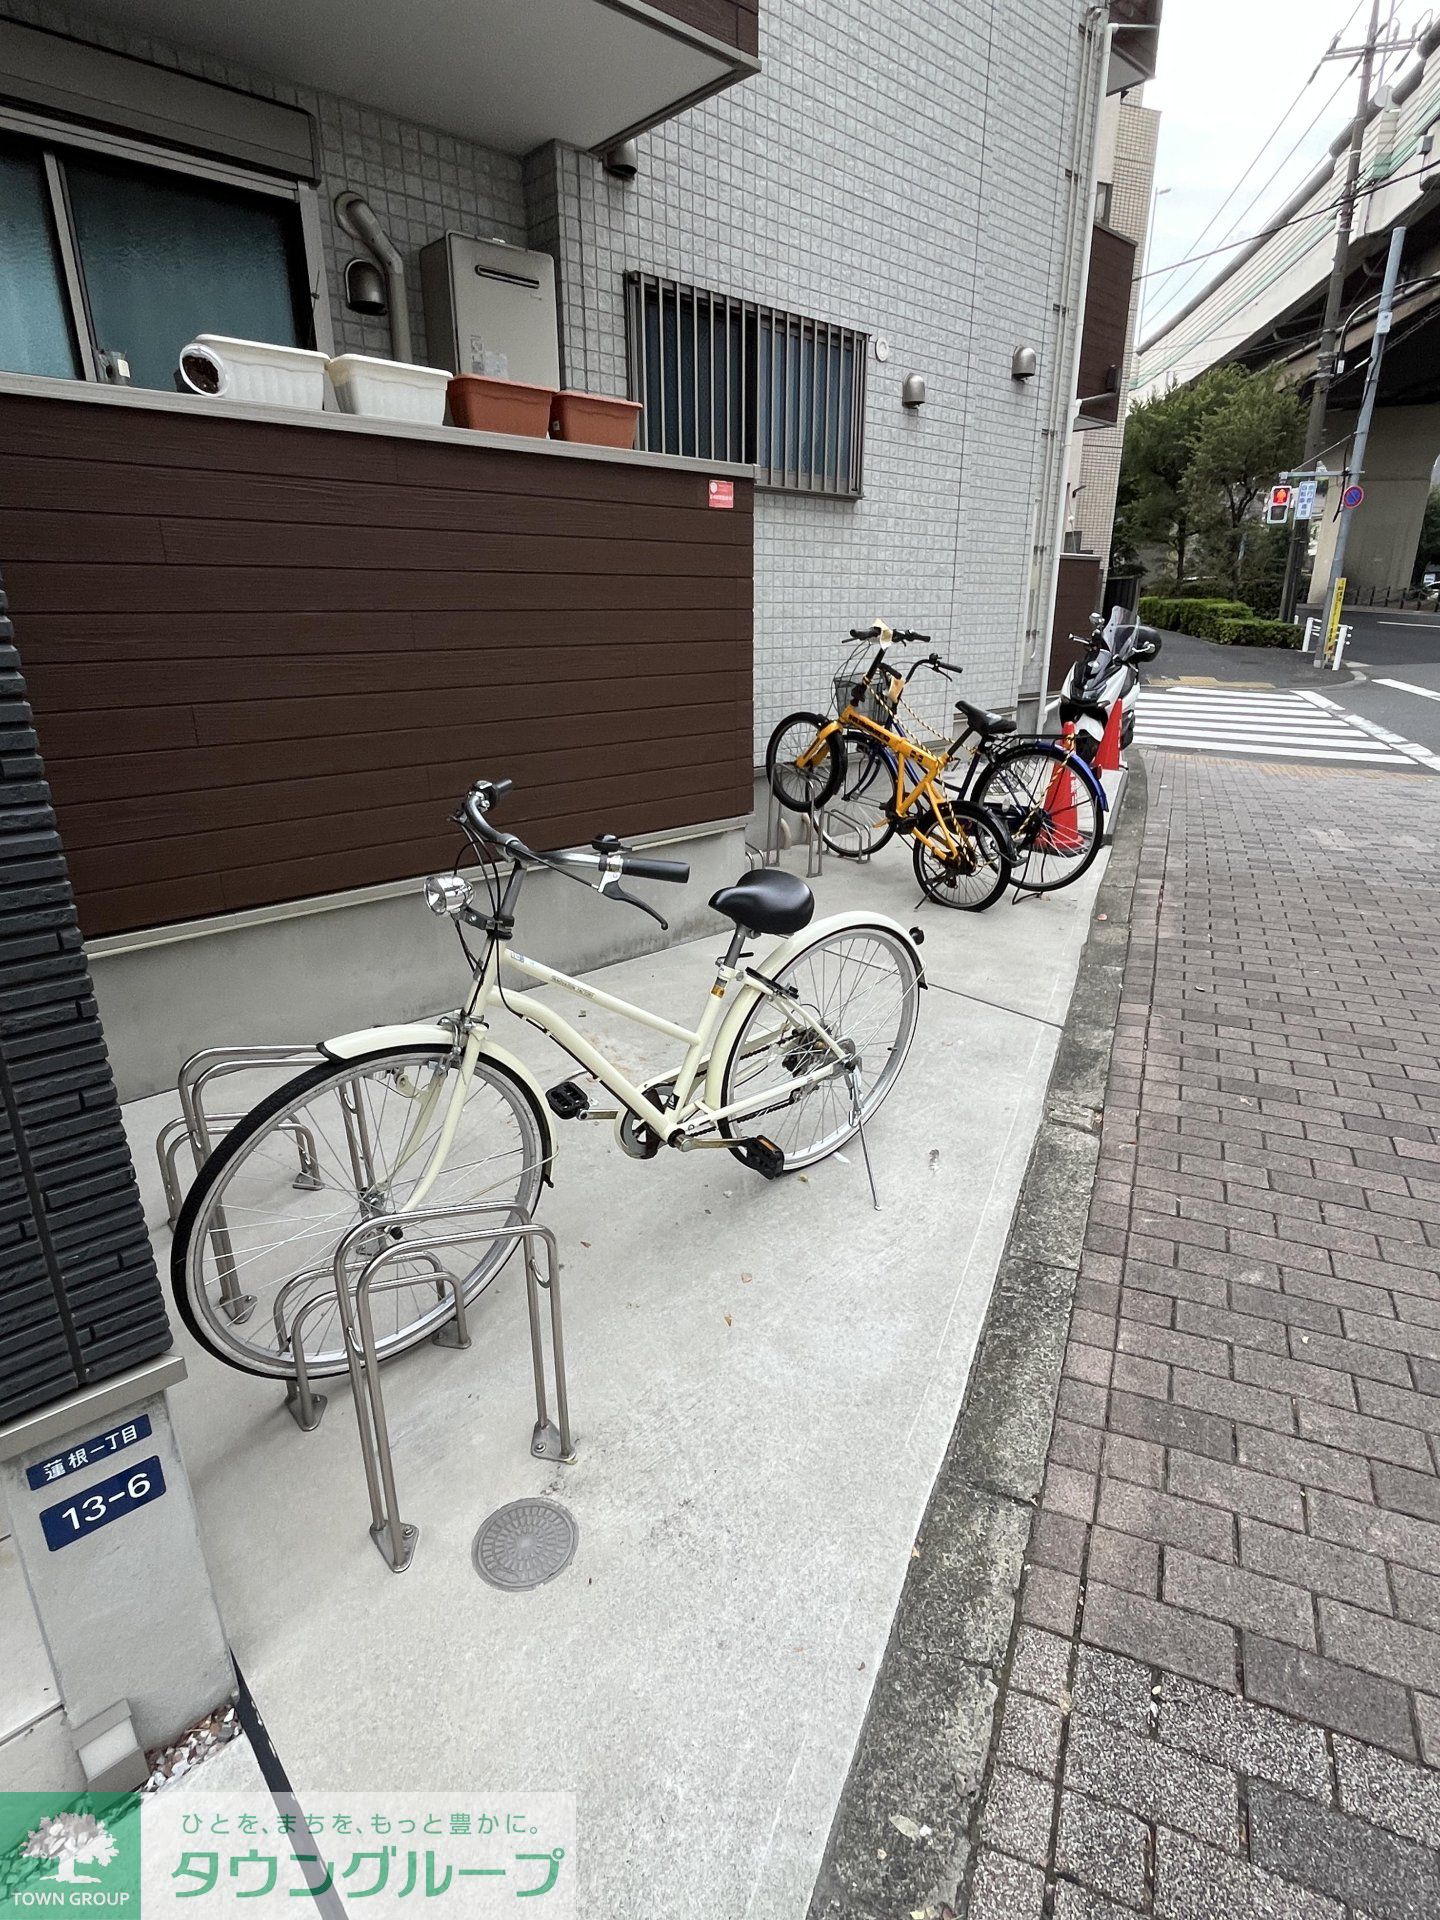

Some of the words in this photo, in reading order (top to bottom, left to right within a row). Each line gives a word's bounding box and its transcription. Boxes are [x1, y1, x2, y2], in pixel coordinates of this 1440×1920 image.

[43, 1424, 138, 1481] 蓮根一丁目
[61, 1472, 151, 1531] 13-6
